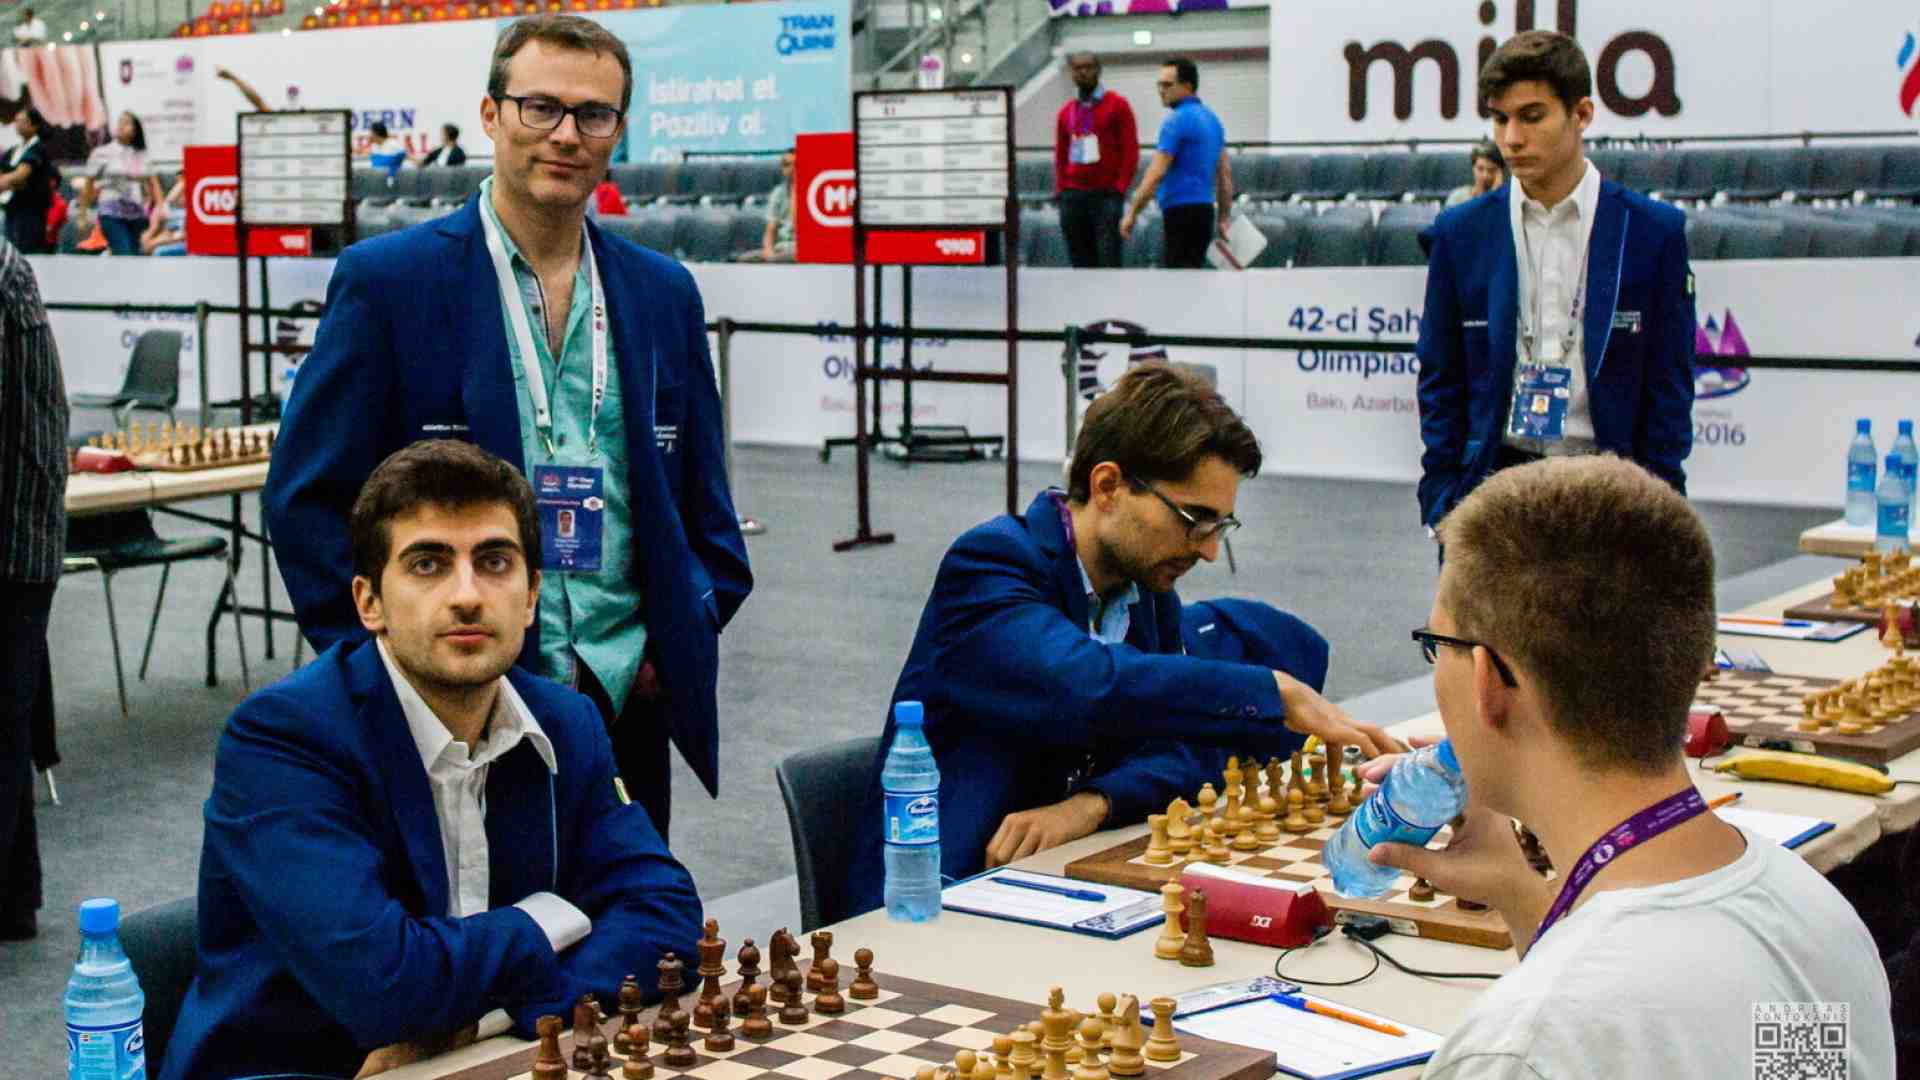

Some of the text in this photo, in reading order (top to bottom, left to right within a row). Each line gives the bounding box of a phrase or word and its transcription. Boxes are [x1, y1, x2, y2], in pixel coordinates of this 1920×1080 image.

[1343, 0, 1682, 120] mia
[1288, 307, 1358, 332] 42-ci
[1694, 422, 1746, 447] 2016
